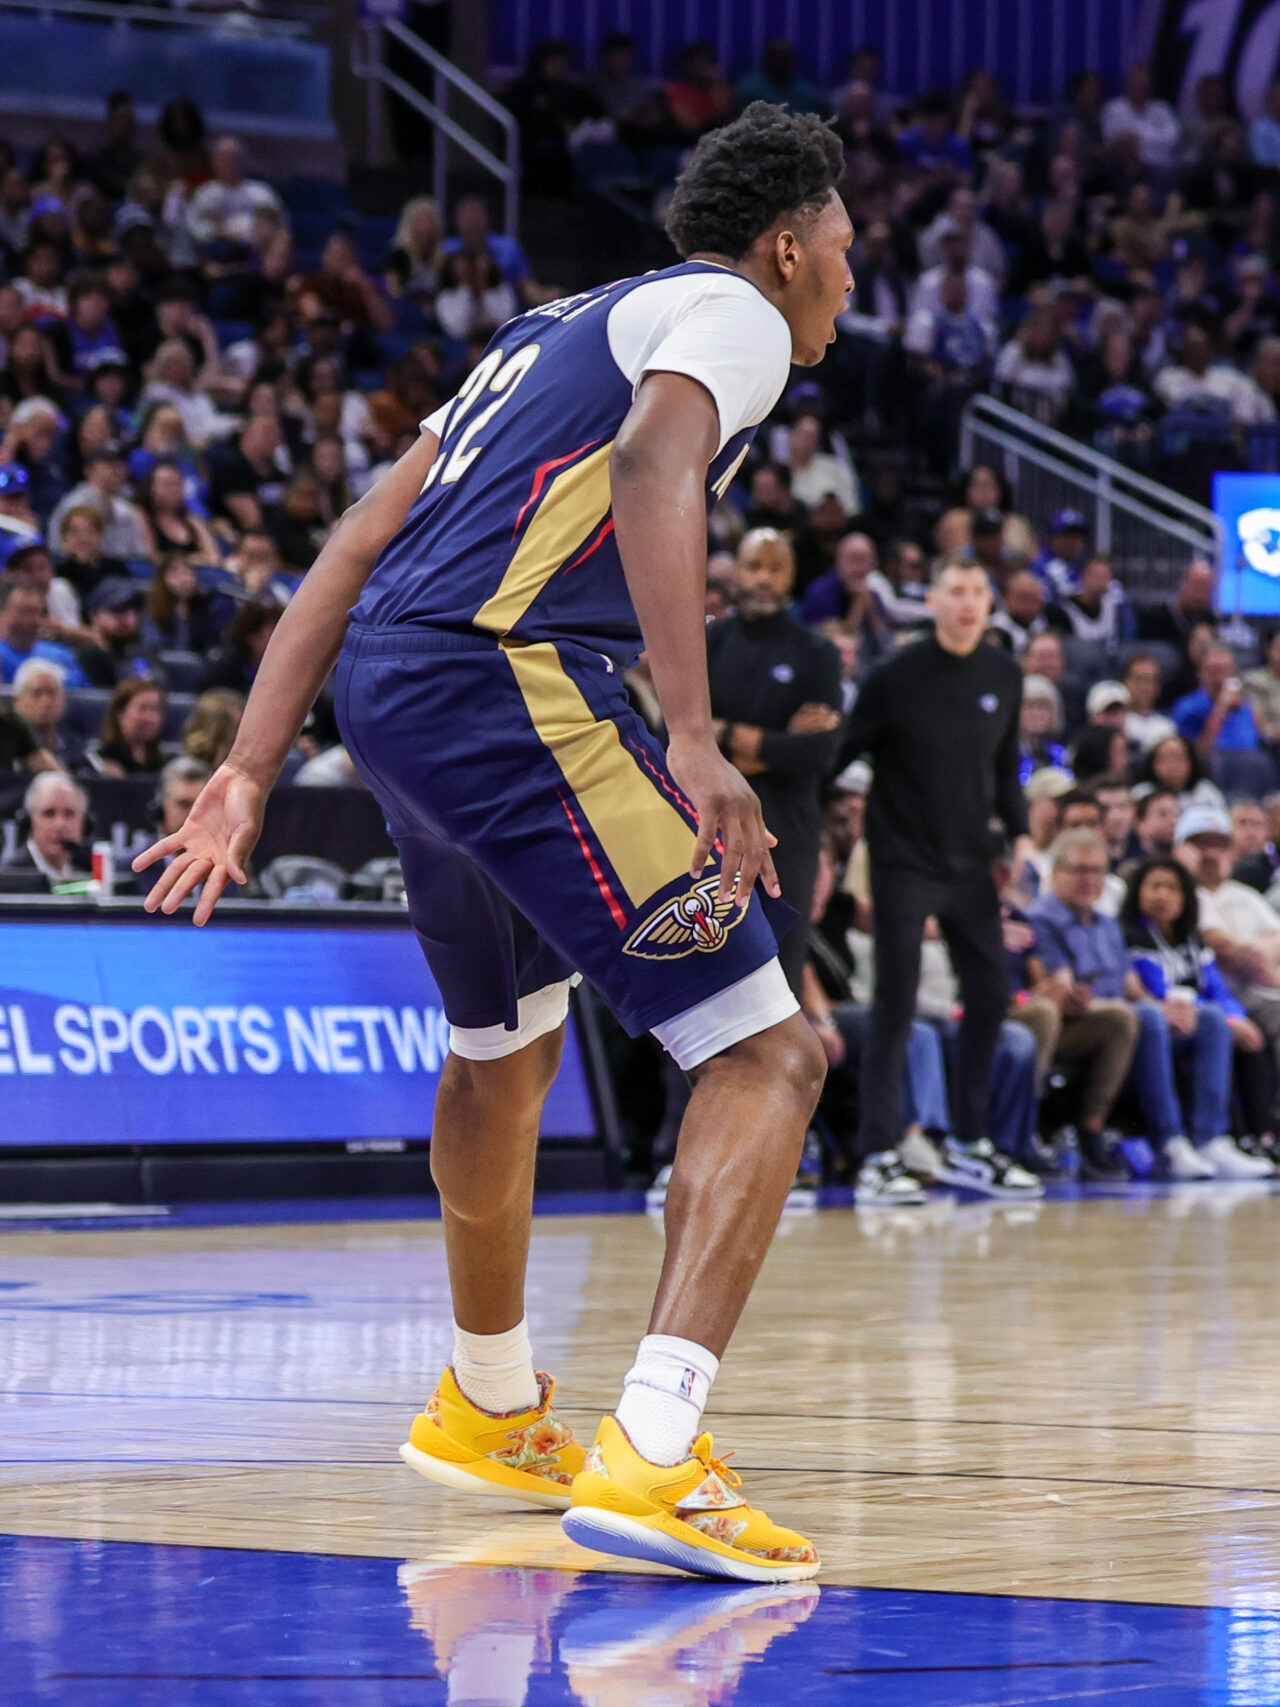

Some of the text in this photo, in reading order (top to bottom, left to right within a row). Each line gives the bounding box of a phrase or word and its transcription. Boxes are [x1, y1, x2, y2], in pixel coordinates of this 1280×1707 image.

[419, 343, 542, 495] 22
[54, 1004, 281, 1075] SPORTS
[284, 1005, 450, 1074] NETW
